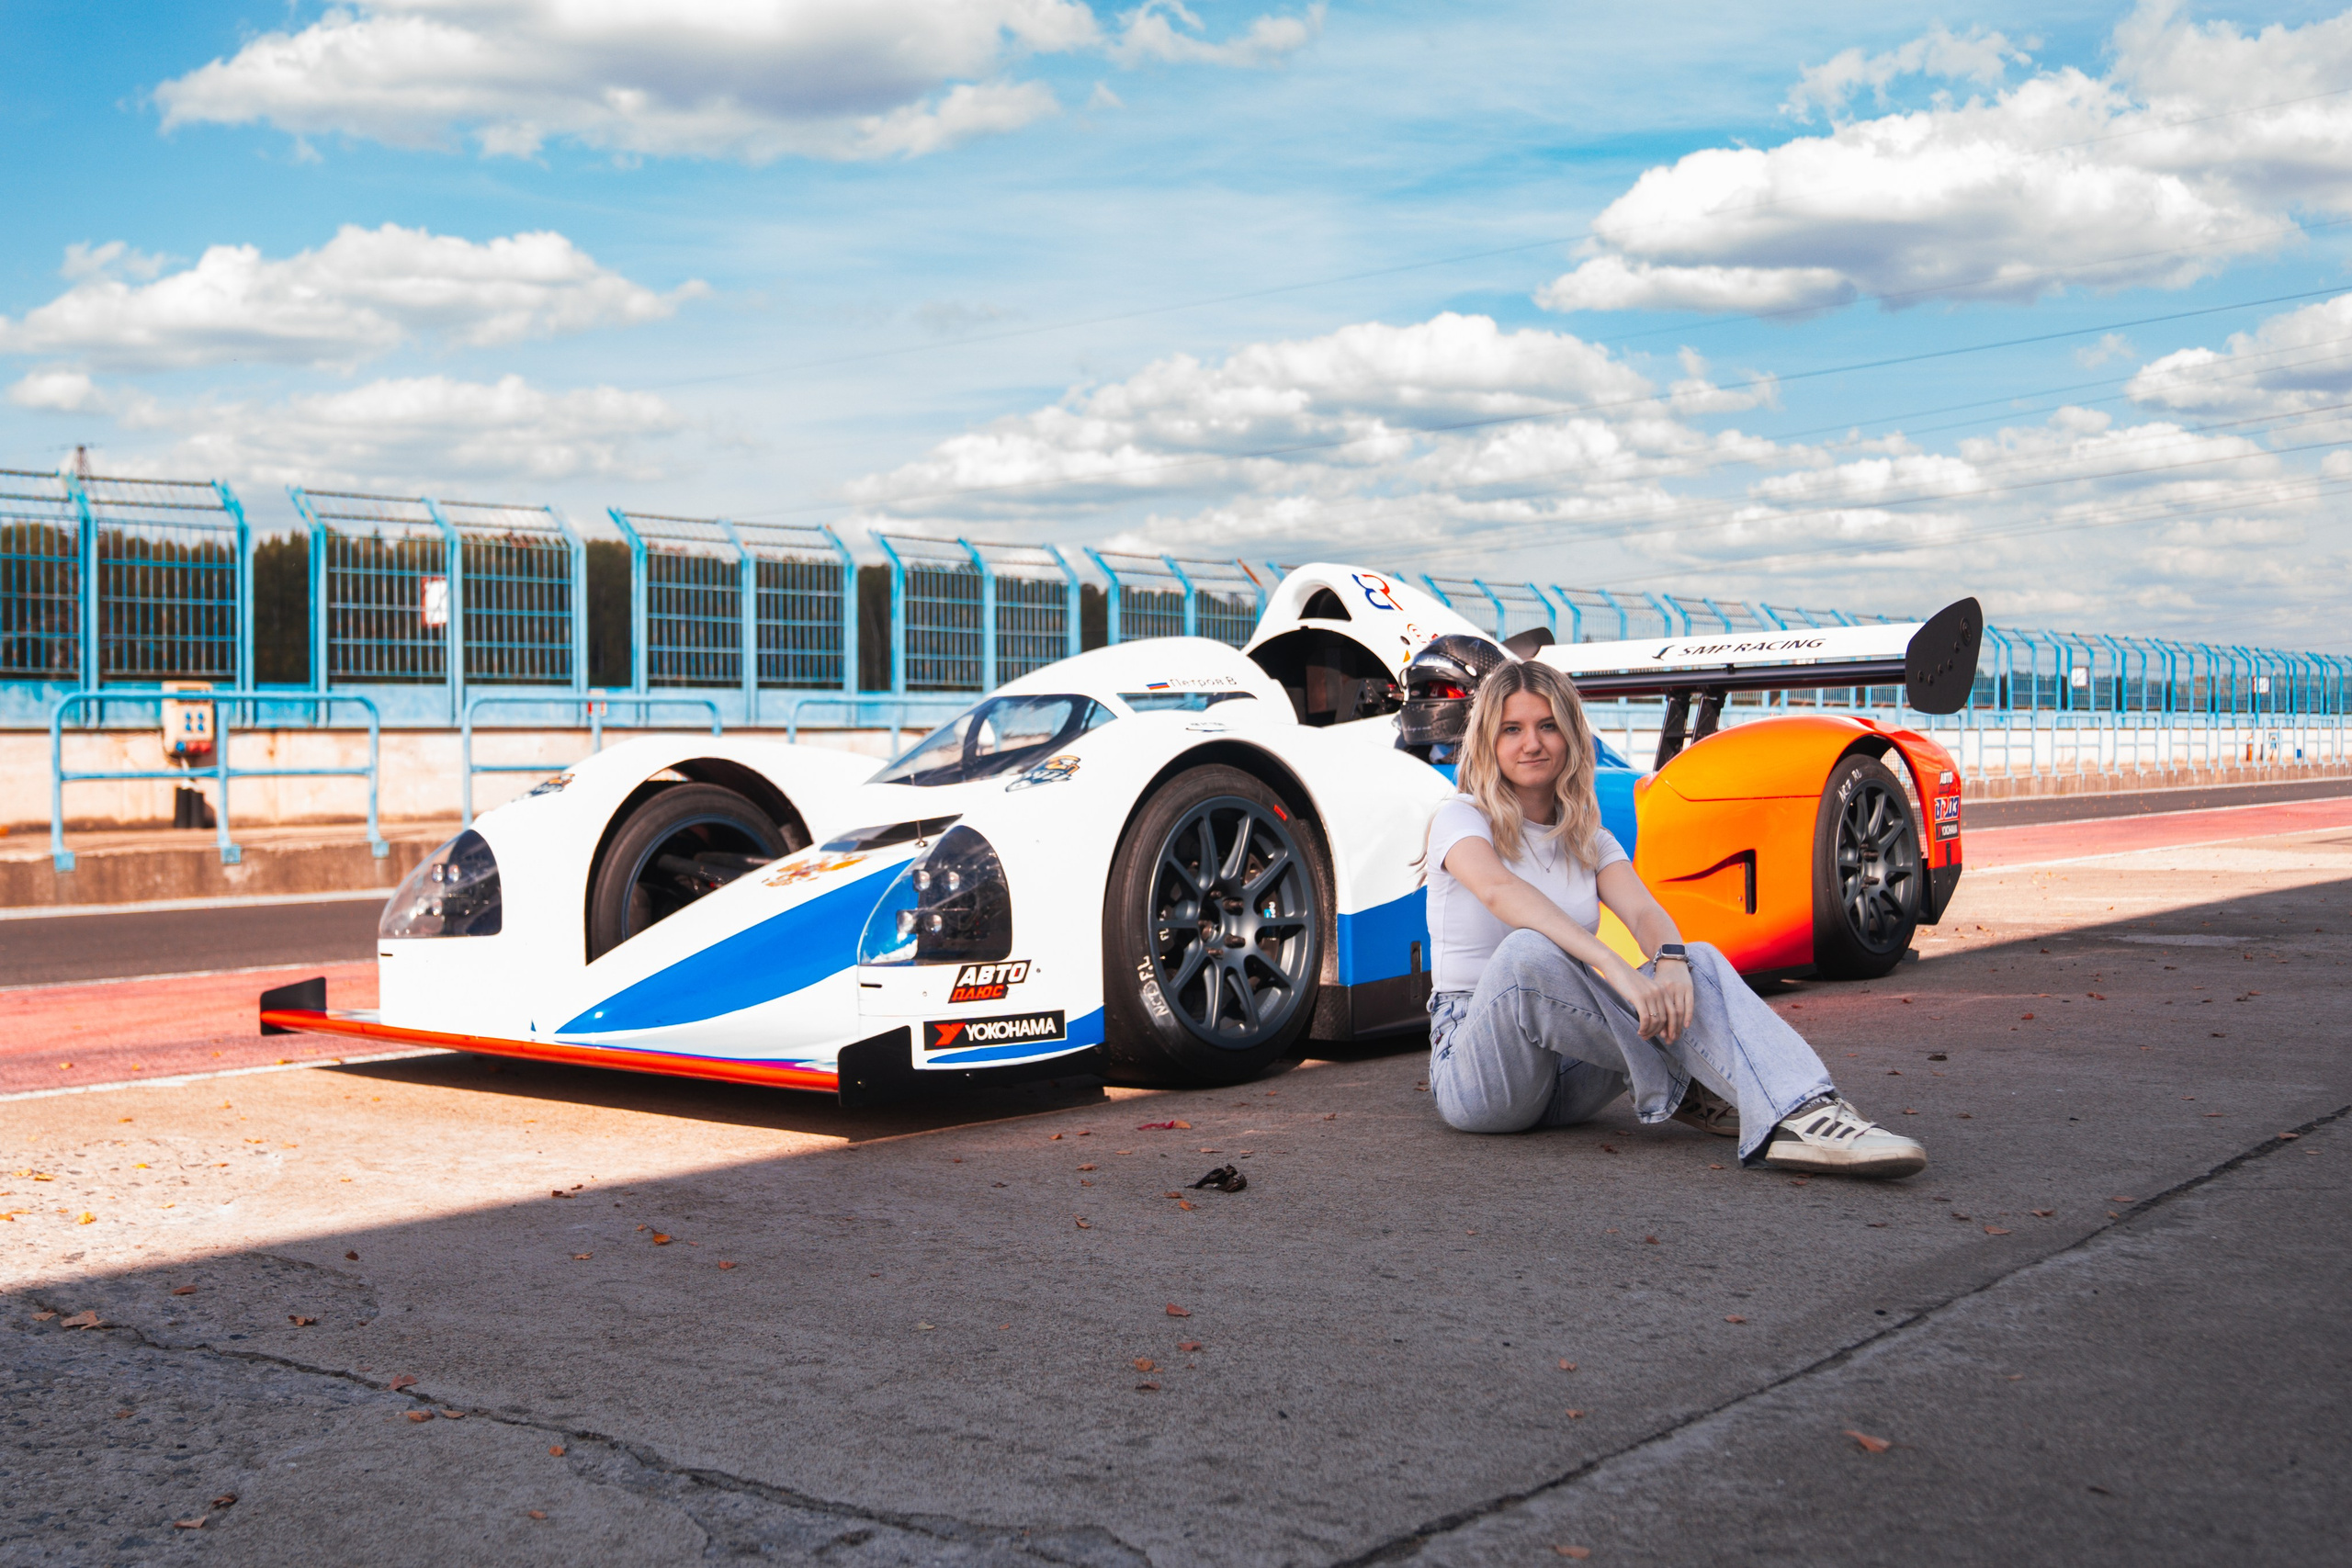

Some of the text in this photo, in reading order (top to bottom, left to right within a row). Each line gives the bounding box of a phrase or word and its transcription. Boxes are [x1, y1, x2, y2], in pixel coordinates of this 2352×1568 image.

[1678, 637, 1826, 657] SMP RACING
[956, 962, 1028, 987] АВТО
[951, 984, 1005, 1001] ПЛЮС
[965, 1017, 1057, 1041] YOKOHAMA
